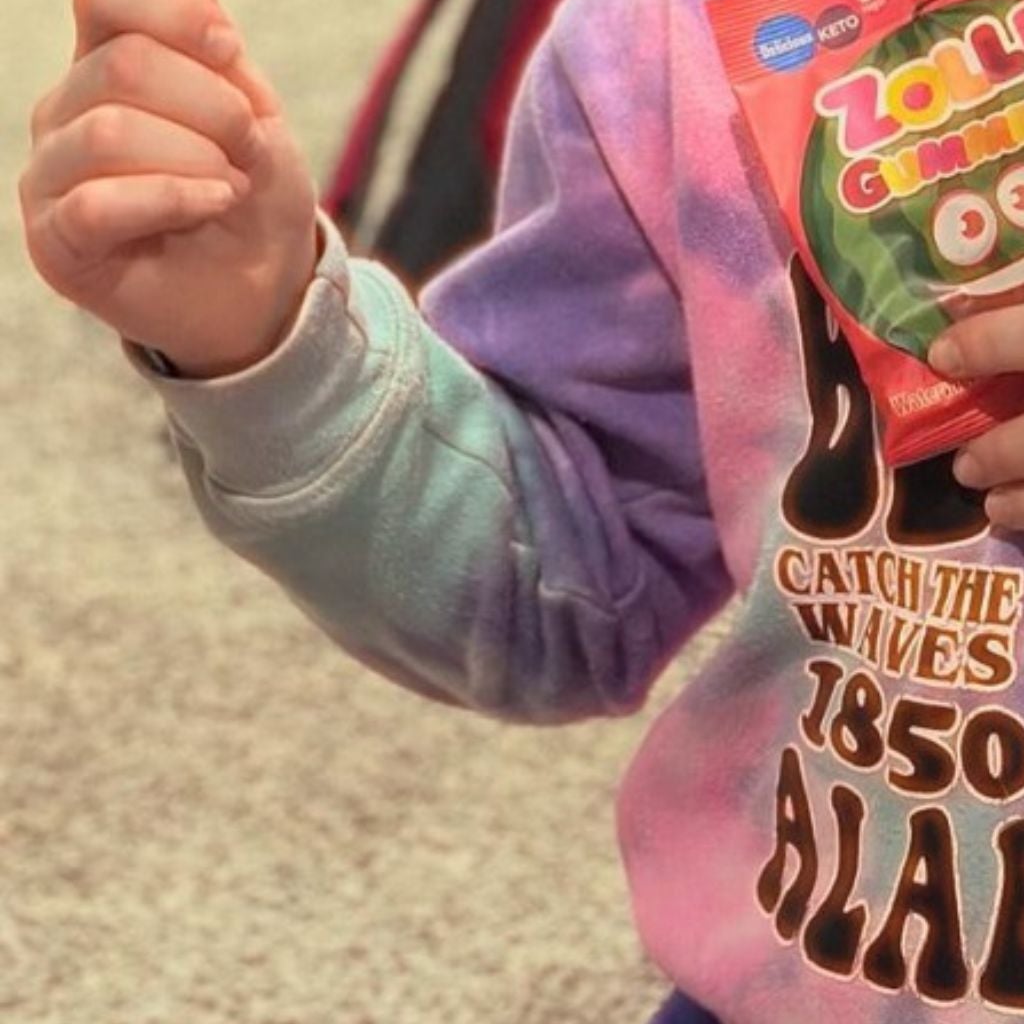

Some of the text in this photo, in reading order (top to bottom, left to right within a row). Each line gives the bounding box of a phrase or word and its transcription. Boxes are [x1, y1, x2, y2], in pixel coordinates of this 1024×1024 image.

[816, 14, 860, 43] KETO
[774, 547, 1024, 627] CATCH THE
[791, 598, 1018, 692] WAVES
